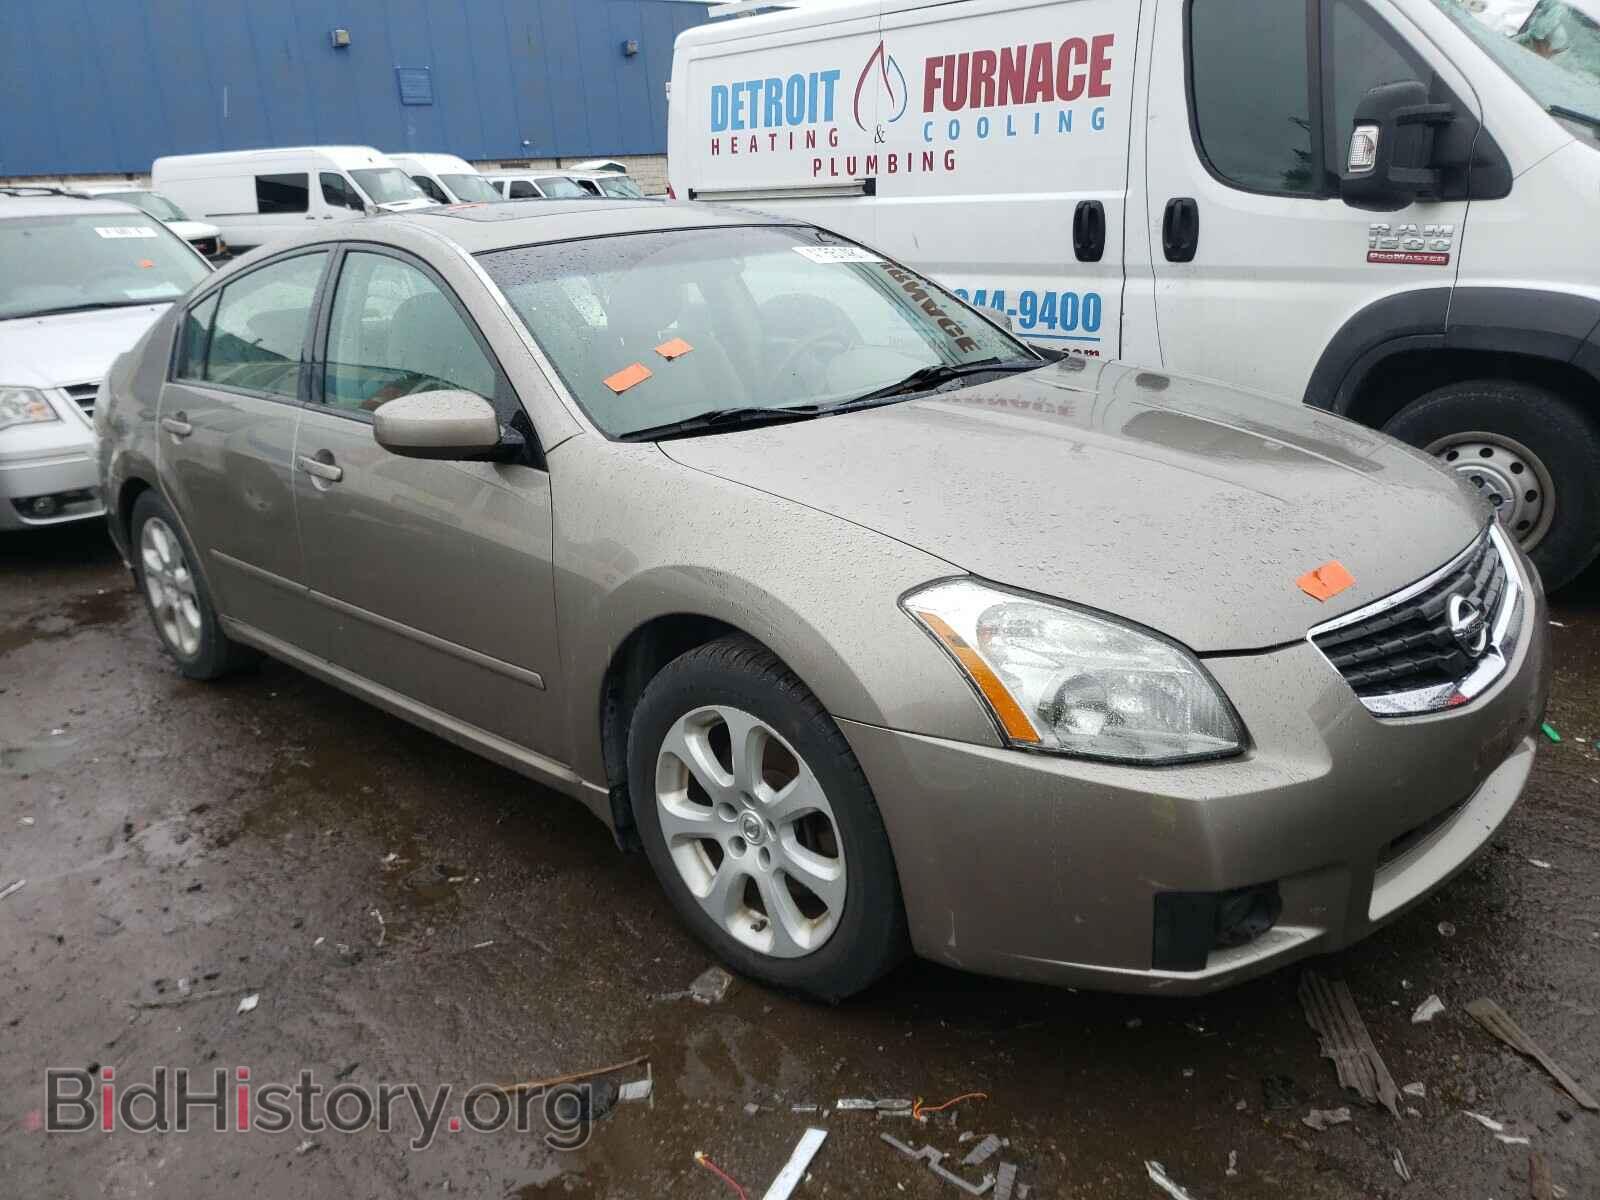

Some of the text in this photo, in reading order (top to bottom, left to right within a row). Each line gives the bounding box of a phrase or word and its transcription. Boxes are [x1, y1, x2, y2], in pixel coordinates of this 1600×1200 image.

[711, 33, 1114, 132] DETROIT FURNACE
[711, 106, 1105, 156] HEATING & COOLING
[812, 150, 955, 177] PLUMBING
[1368, 223, 1454, 237] RAM
